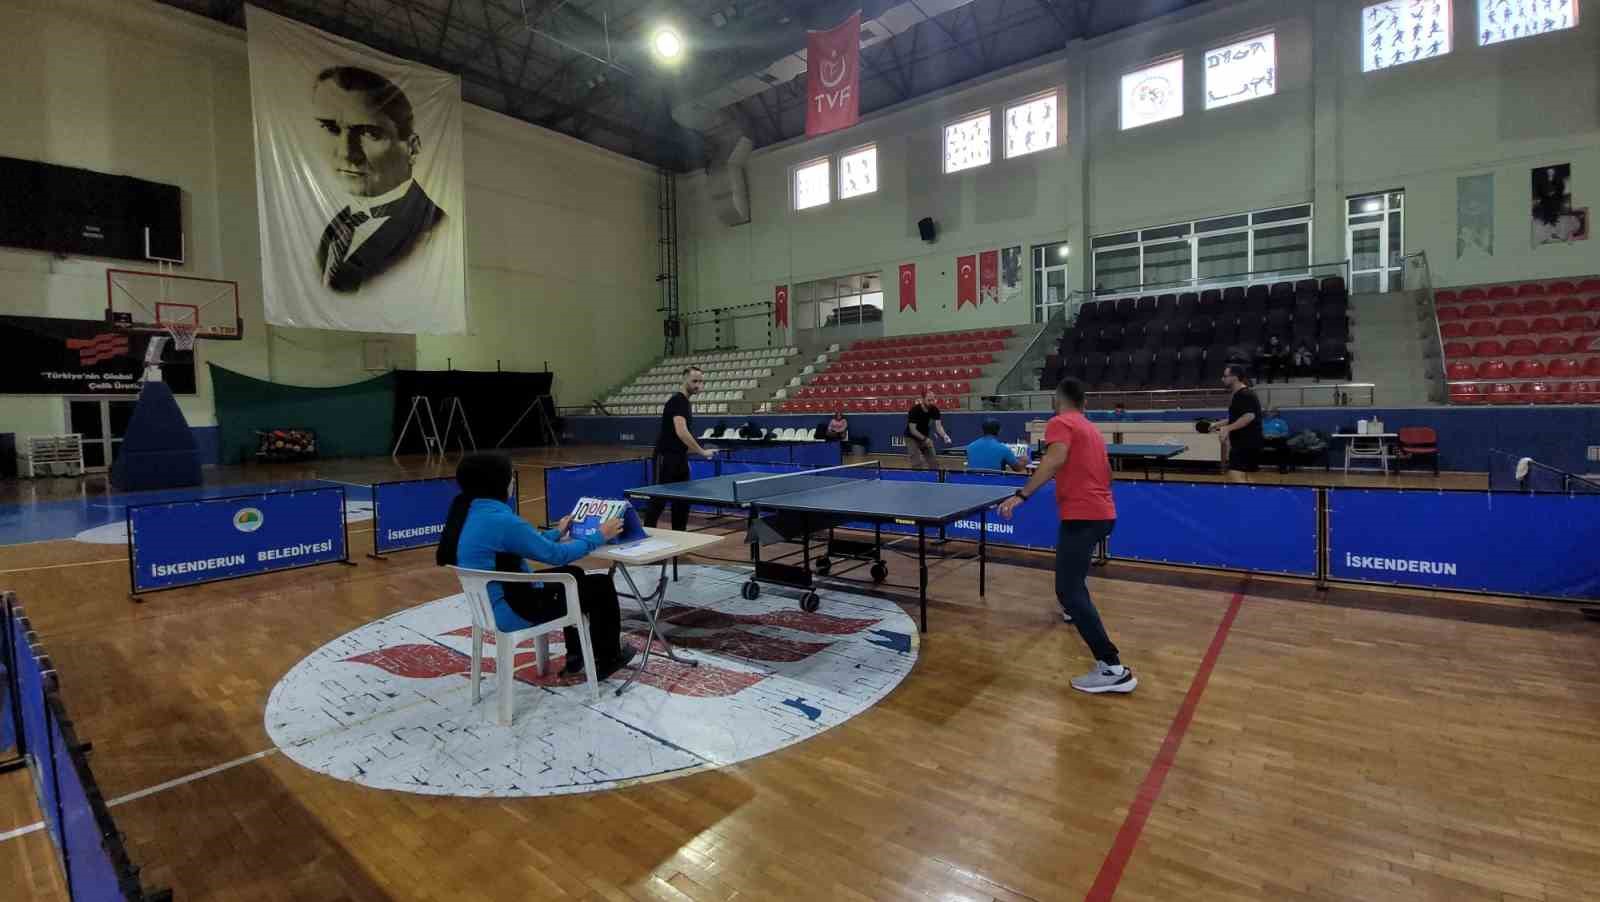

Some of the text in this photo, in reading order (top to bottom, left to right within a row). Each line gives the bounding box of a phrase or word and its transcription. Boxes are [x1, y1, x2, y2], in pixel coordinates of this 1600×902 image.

[814, 86, 851, 113] TVF
[388, 523, 446, 540] İSKENDERU
[152, 539, 332, 577] İSKENDERUN BELEDİYESİ
[1346, 552, 1456, 575] İSKENDERUN
